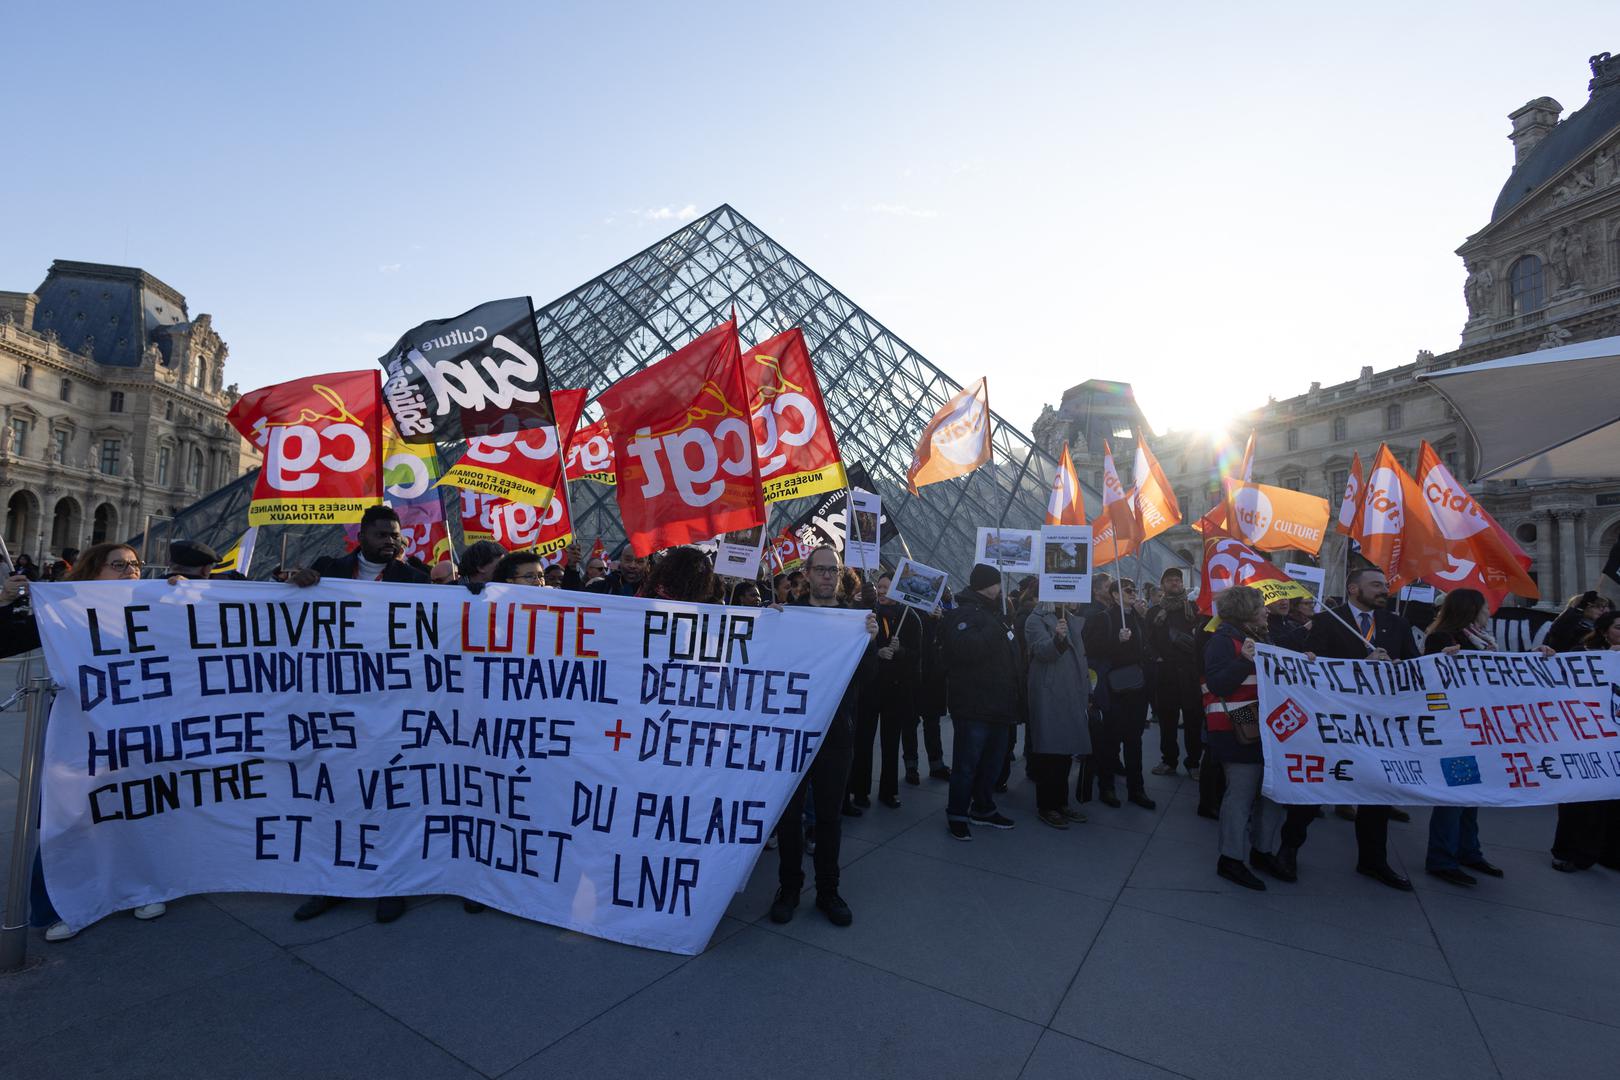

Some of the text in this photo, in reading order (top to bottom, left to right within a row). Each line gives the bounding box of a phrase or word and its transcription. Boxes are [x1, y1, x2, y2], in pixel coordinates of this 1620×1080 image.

[1273, 519, 1320, 541] CULTURE
[87, 601, 755, 664] LE LOUVRE EN LUTTE POUR
[78, 651, 810, 715] DES CONDITIONS DE TRAVAIL DÉCENTES
[1257, 650, 1427, 696] TARIFICATION
[88, 712, 265, 776] HAUSSE
[288, 712, 357, 751] DES
[401, 709, 575, 759] SALAIRES
[1272, 701, 1304, 735] cgt
[1315, 712, 1443, 748] EGALITE
[1459, 700, 1618, 746] SACRIFIEE
[1380, 759, 1427, 786] POUR
[1561, 751, 1609, 780] POUR
[88, 754, 766, 845] CONTRE LA VÉTUSTÉ DU PALAIS
[256, 814, 700, 916] ET LE PROJET LNR
